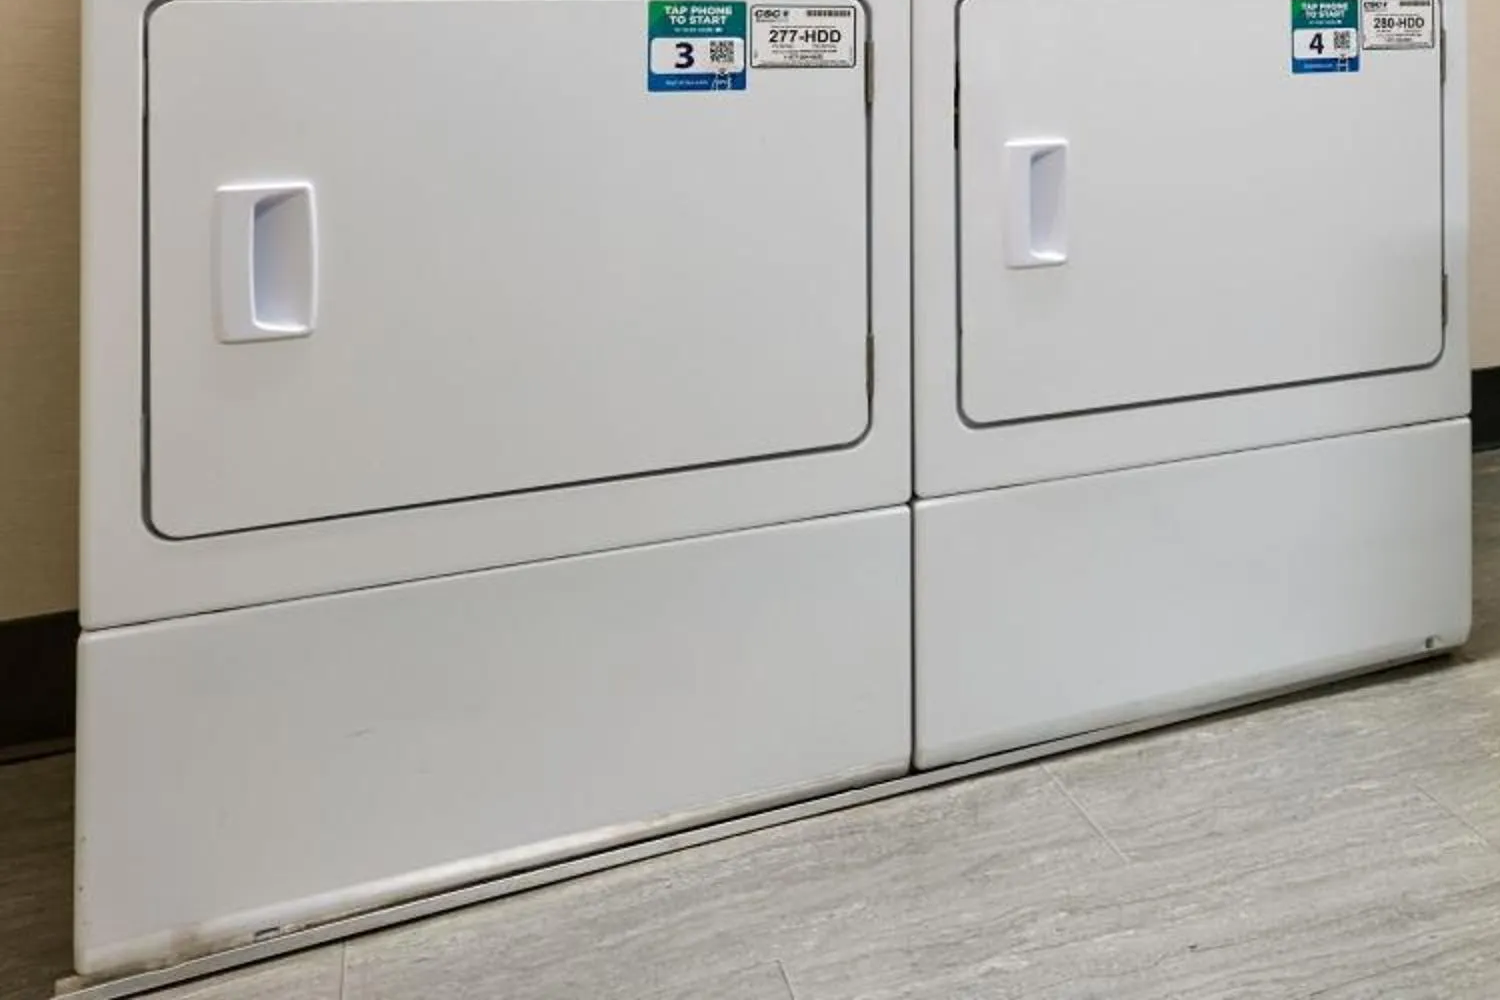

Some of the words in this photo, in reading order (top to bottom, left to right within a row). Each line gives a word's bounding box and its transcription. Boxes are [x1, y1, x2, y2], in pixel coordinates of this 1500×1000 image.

[664, 4, 689, 15] TAP
[691, 4, 733, 16] PHONE
[754, 9, 780, 19] CSC
[669, 15, 687, 25] TO
[689, 15, 727, 26] START
[1373, 17, 1425, 29] 280-HDD
[768, 29, 841, 44] 277-HDD
[1309, 32, 1325, 55] 4
[674, 41, 695, 69] 3
